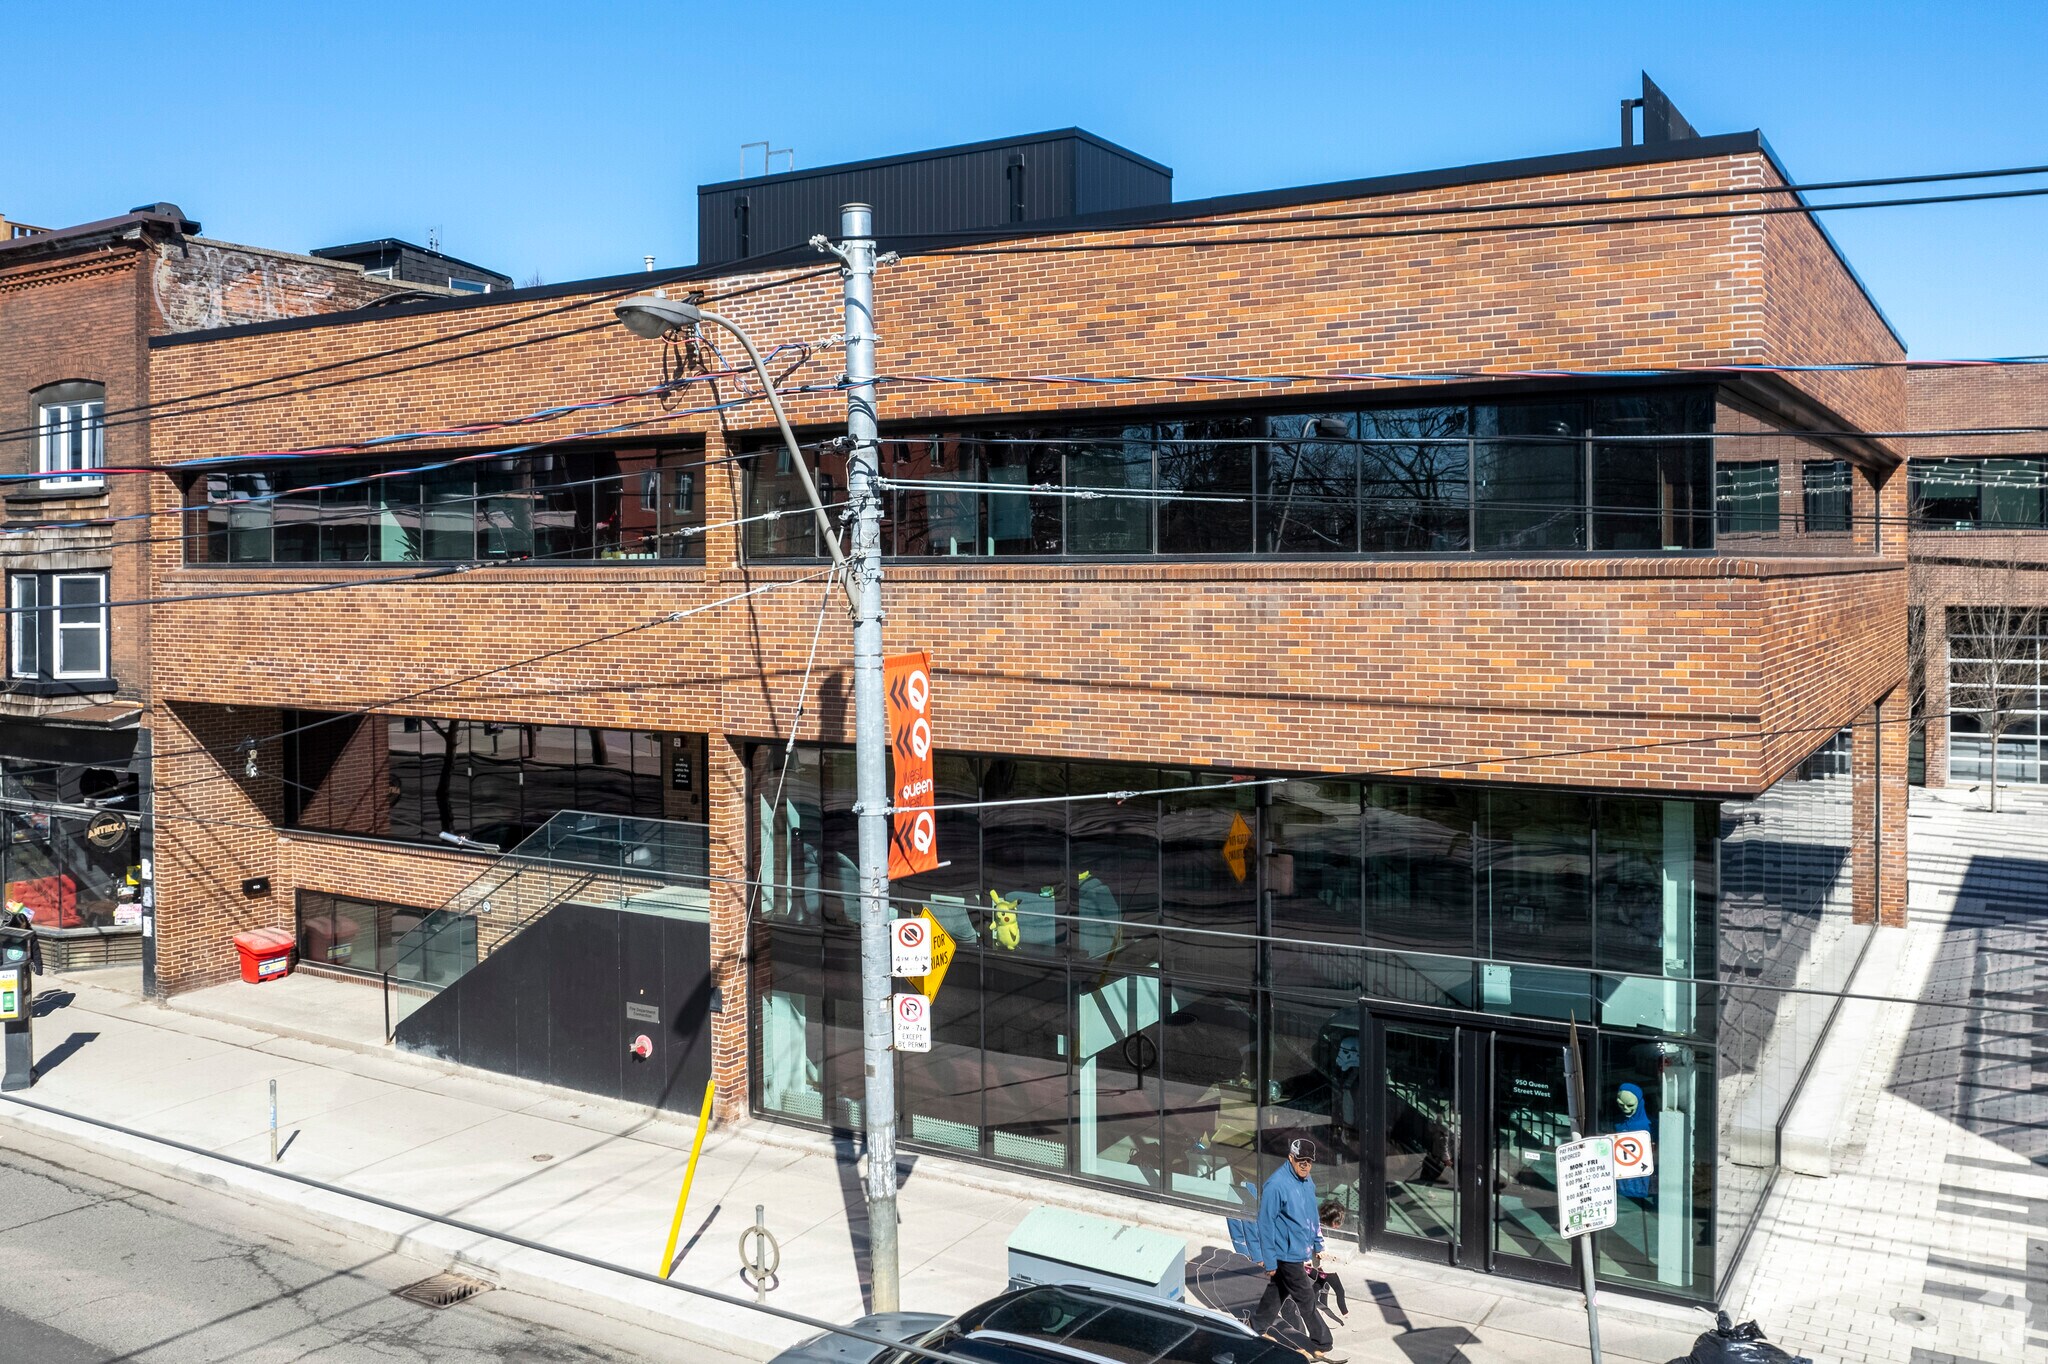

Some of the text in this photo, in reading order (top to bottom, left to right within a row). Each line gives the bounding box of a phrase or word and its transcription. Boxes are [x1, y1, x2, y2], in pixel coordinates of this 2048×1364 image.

[903, 778, 933, 800] Queen
[88, 822, 126, 839] ANTIKKA
[933, 933, 946, 950] FOR
[907, 1041, 927, 1049] PERMIT
[1515, 1079, 1549, 1089] 950 Queen
[1513, 1086, 1551, 1098] Street West
[1559, 1151, 1581, 1163] ENFORCED
[1570, 1162, 1583, 1171] MON
[1579, 1182, 1590, 1190] SAT
[1580, 1196, 1592, 1204] SUN
[1582, 1207, 1608, 1219] 4211
